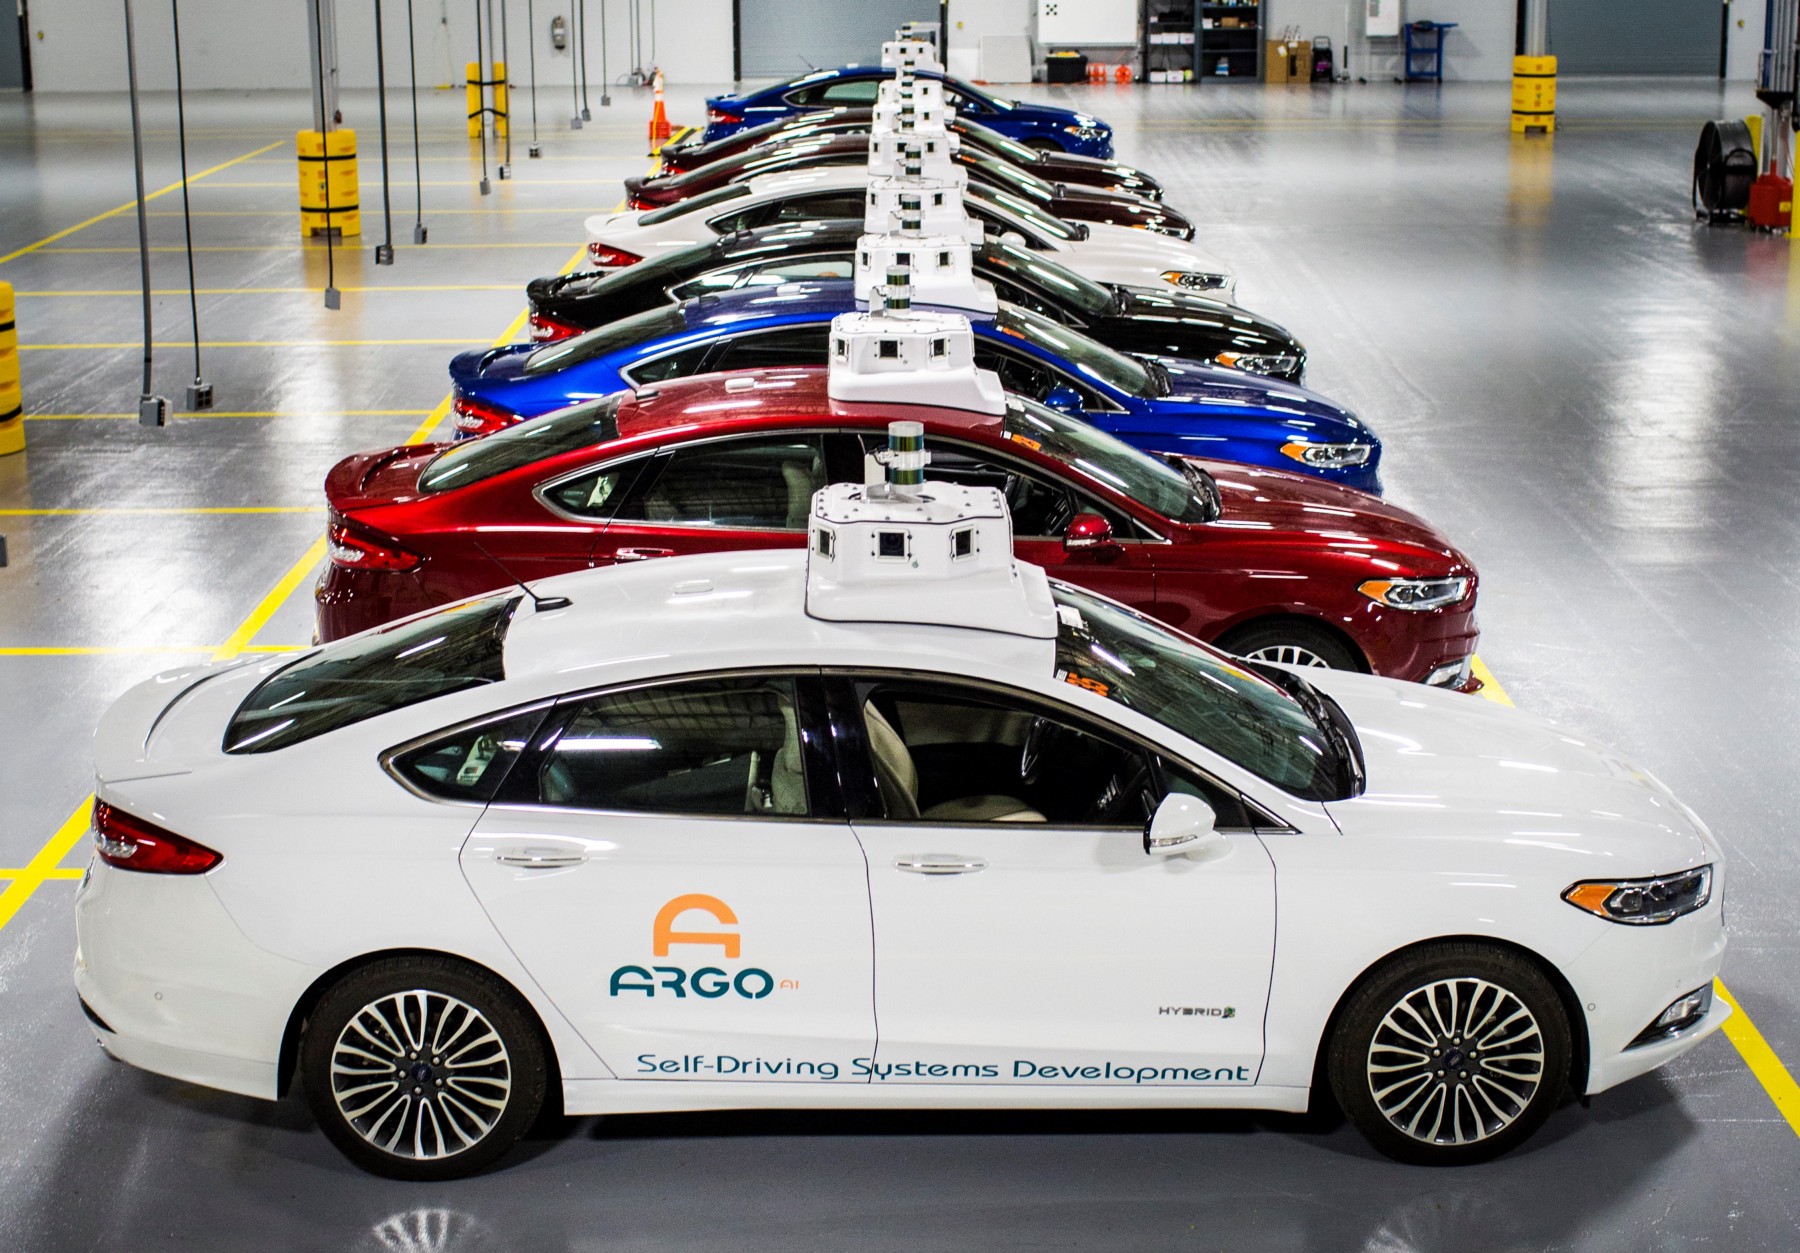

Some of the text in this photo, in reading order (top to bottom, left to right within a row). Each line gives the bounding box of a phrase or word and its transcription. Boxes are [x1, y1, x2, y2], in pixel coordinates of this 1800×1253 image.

[609, 965, 799, 999] ARGO AI
[1158, 1006, 1222, 1017] HYBRID
[637, 1054, 1250, 1084] Self-Driving Systems Development
